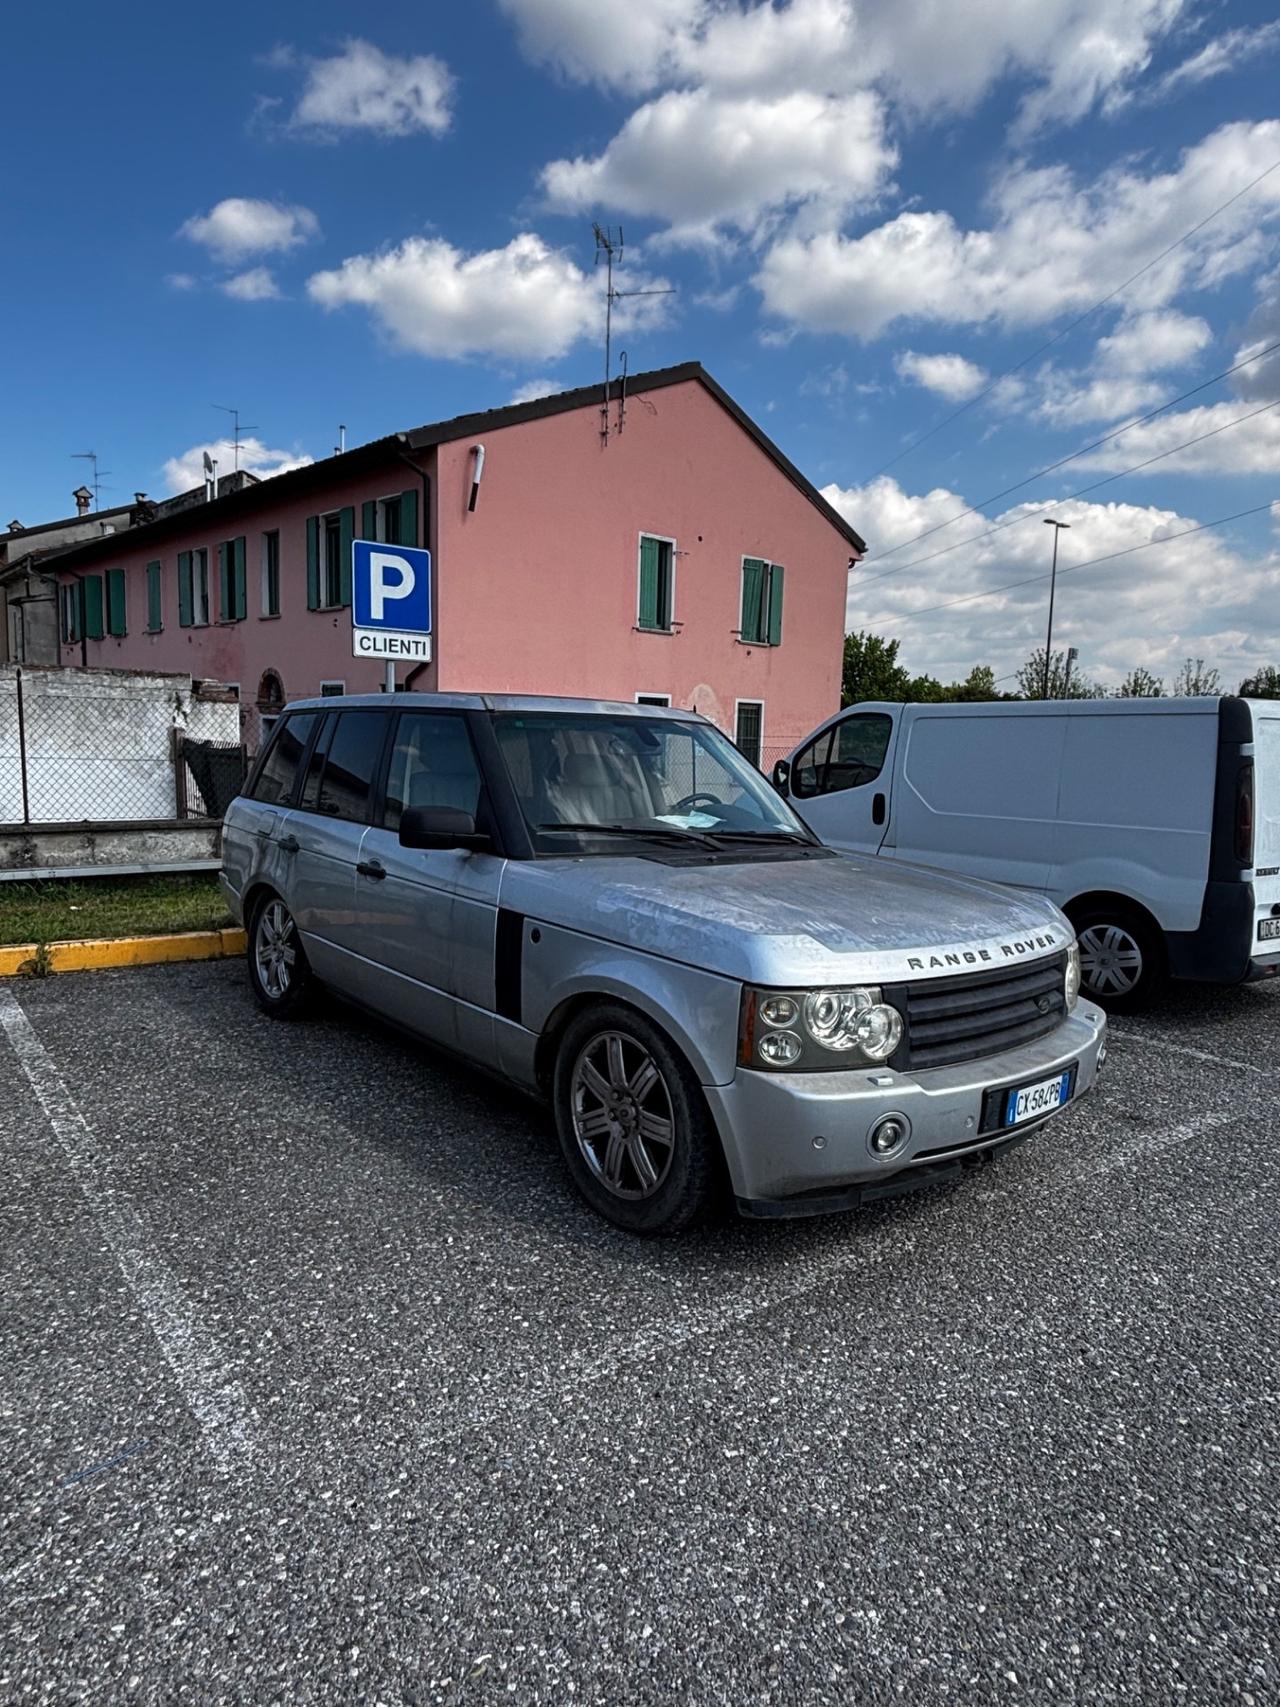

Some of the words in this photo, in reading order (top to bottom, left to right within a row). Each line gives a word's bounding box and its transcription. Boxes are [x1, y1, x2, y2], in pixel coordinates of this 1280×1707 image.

[370, 552, 415, 620] P
[360, 636, 426, 656] CLIENTI
[907, 949, 992, 970] RANGE
[1000, 934, 1056, 957] ROVER
